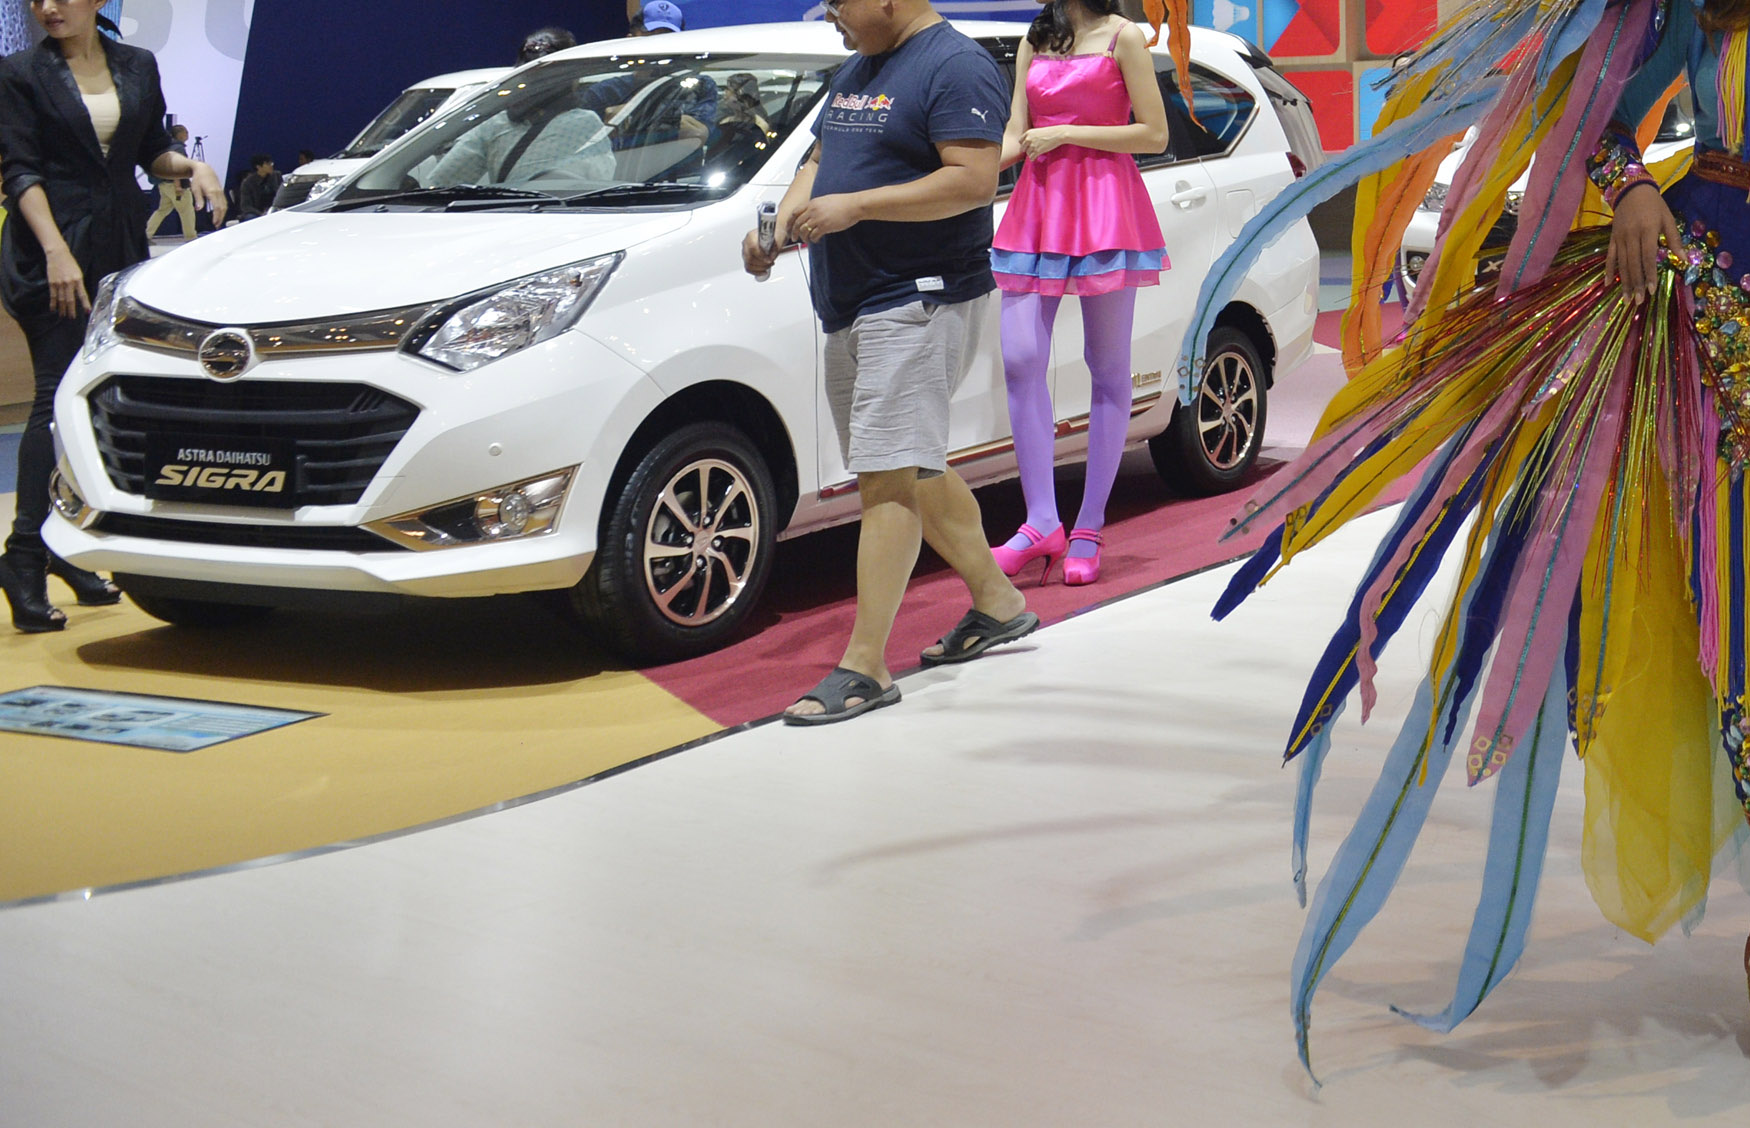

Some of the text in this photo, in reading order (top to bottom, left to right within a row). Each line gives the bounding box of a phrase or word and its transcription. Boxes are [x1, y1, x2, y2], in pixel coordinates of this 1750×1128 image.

[826, 110, 888, 122] RACING
[177, 448, 271, 465] ASTRA DAIHATSU
[155, 464, 287, 493] SIGRA
